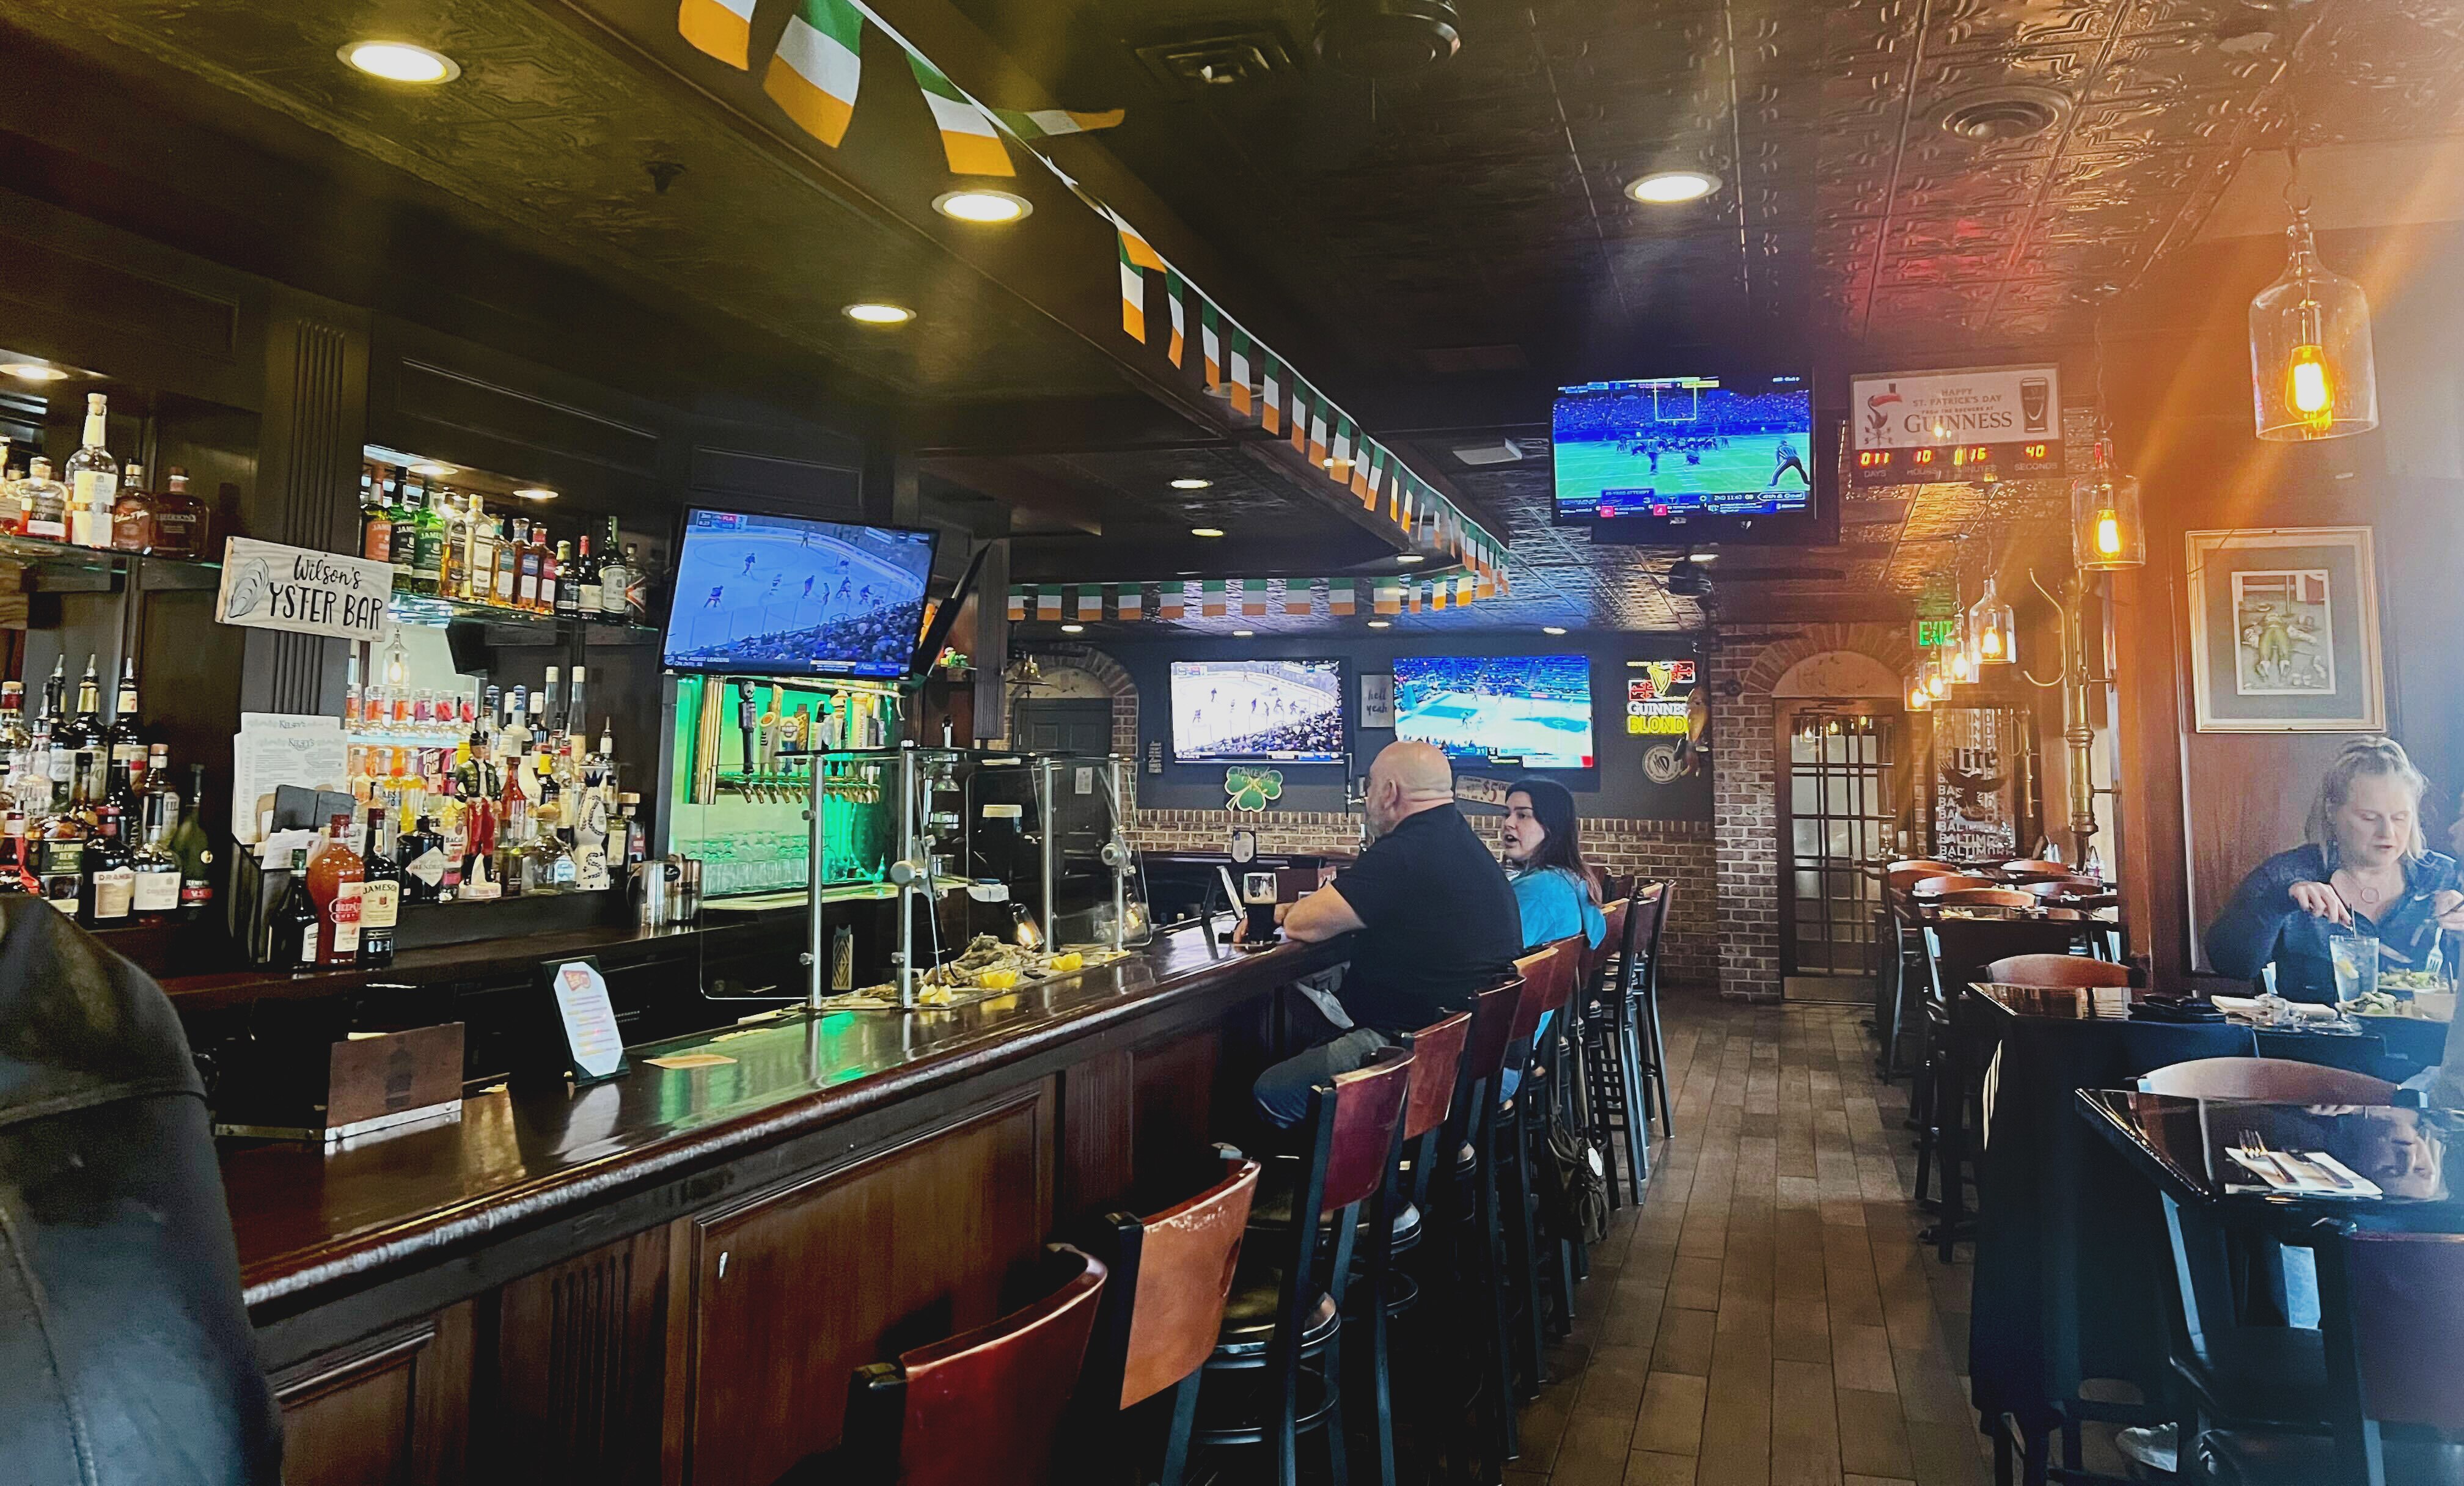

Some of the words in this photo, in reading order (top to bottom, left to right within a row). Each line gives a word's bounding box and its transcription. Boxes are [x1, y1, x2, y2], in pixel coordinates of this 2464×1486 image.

[1942, 387, 1973, 397] HAPPY
[1930, 395, 1979, 406] PATRICK'S
[1982, 394, 2002, 403] DAY
[1904, 411, 2012, 433] GUINNESS
[1916, 450, 1932, 463] 10
[2026, 444, 2045, 457] 40
[1861, 452, 1890, 466] 011
[2014, 463, 2058, 471] SECONDS
[294, 555, 362, 589] Wilson's
[343, 594, 383, 630] BAR
[1919, 621, 1954, 646] EXIT
[1368, 687, 1387, 701] hell
[1366, 702, 1388, 716] yeah
[1627, 701, 1689, 716] GUINNES
[1627, 715, 1690, 734] BLOND
